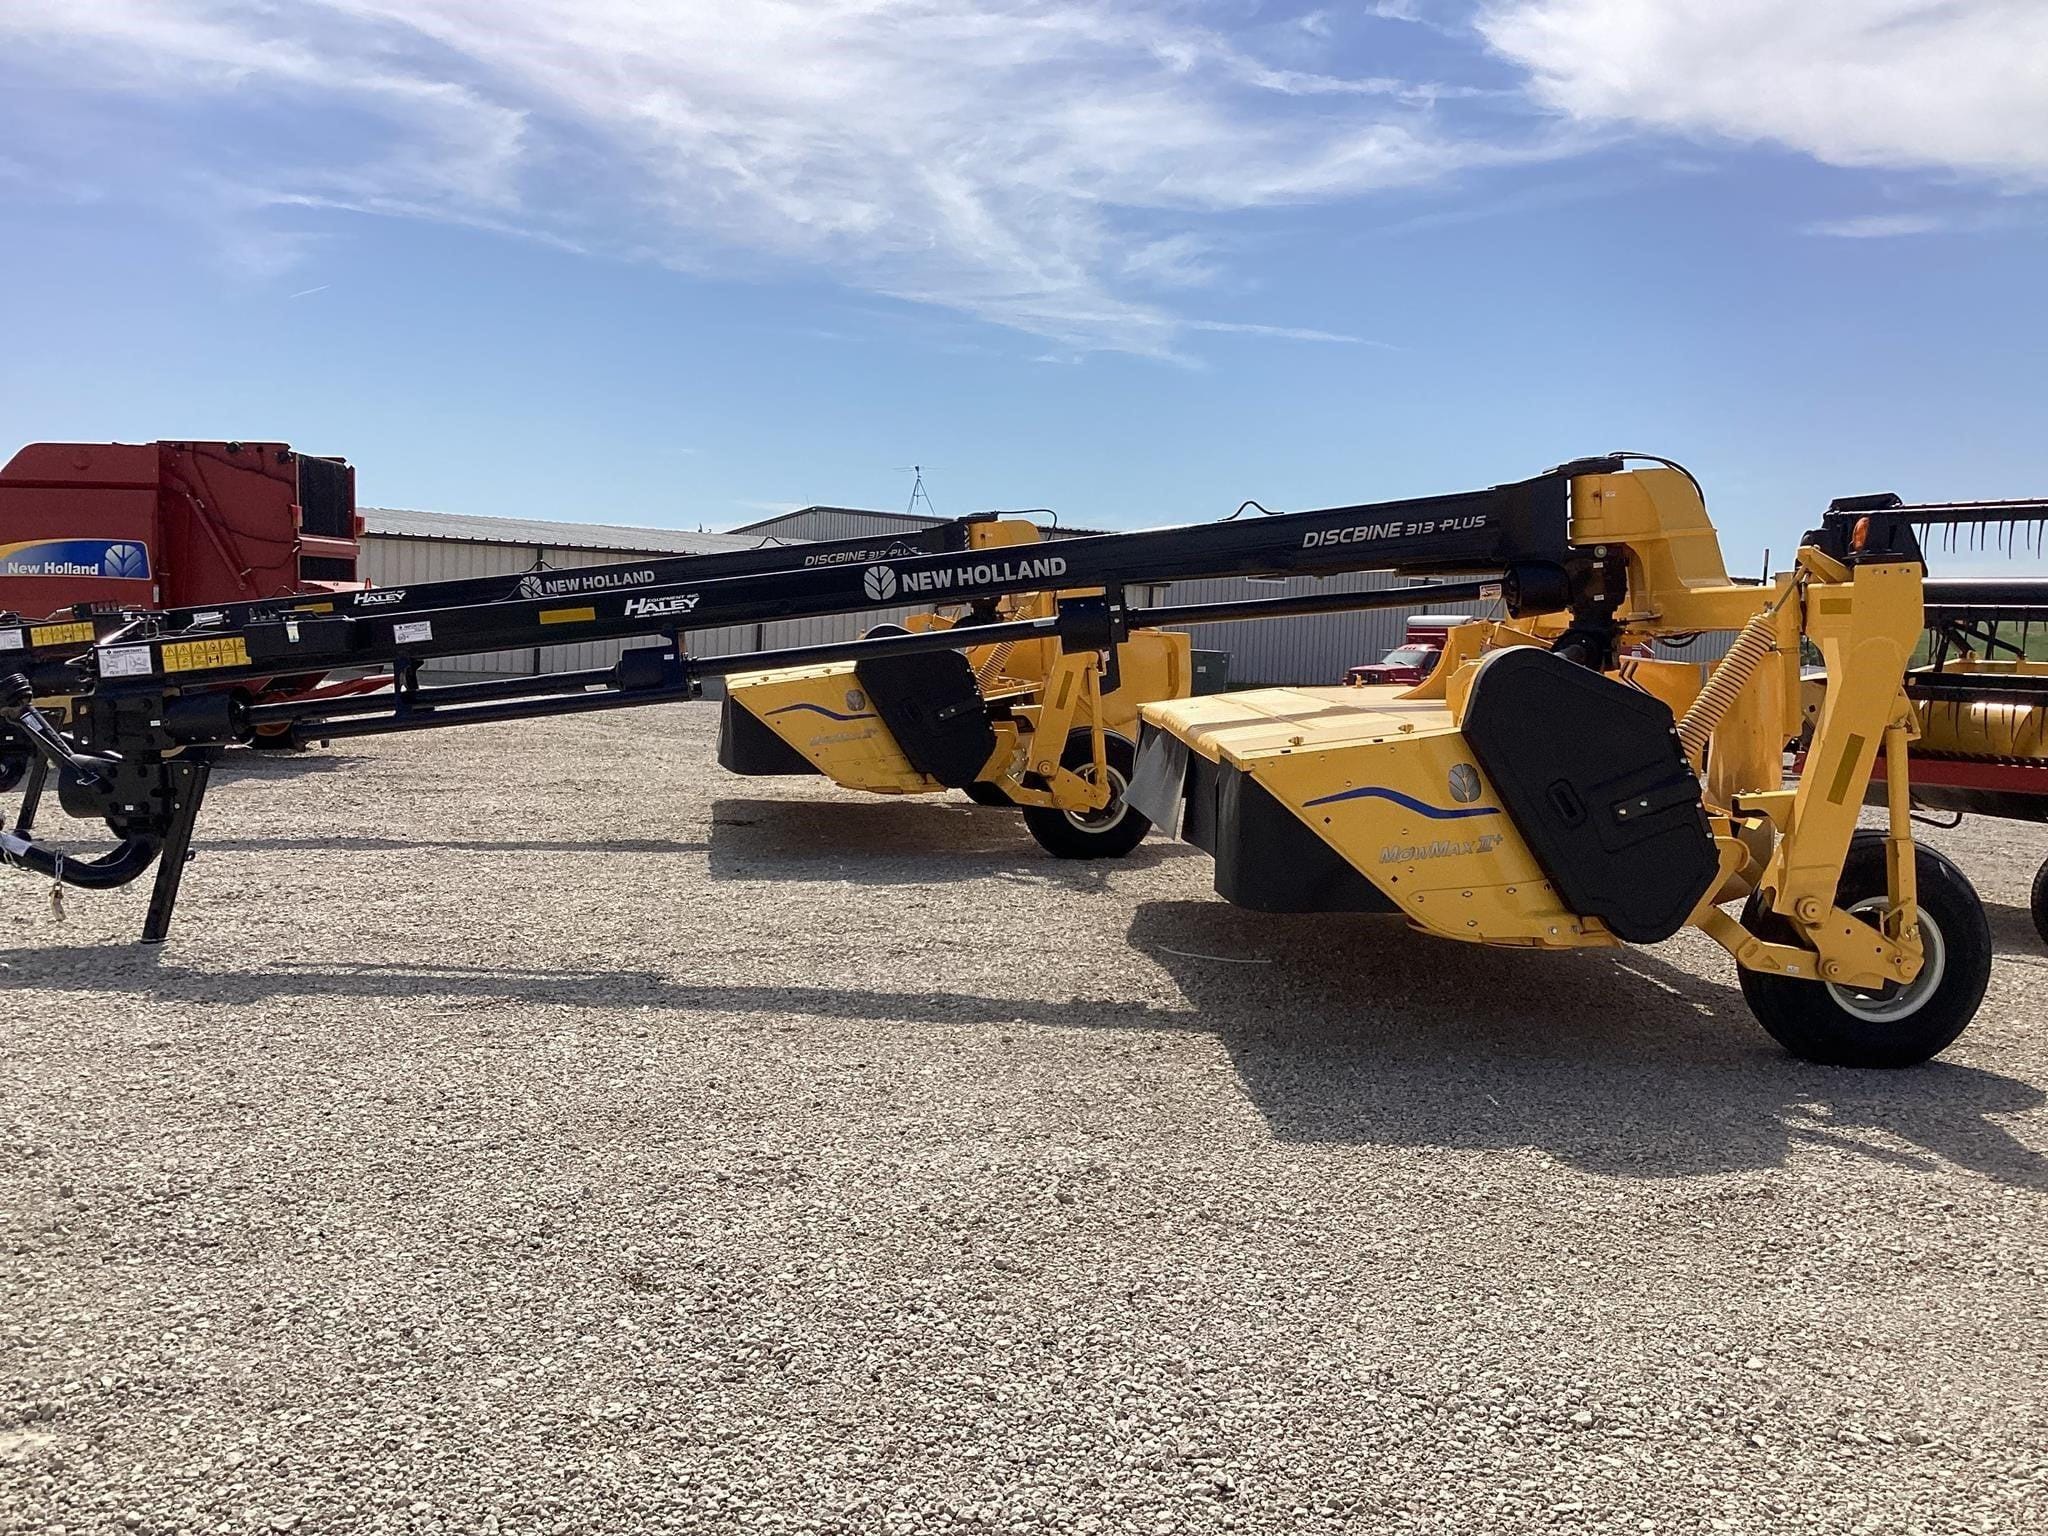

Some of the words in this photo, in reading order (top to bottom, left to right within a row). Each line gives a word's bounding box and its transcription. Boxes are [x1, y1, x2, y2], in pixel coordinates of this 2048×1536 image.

[1302, 522, 1403, 548] DISCBINE
[1405, 522, 1434, 536] 313
[804, 550, 867, 567] DISCBINE
[7, 562, 40, 574] New
[44, 562, 99, 575] Holland
[902, 569, 952, 592] NEW
[957, 557, 1067, 586] HOLLAND
[546, 578, 579, 593] NEW
[583, 571, 655, 590] HOLLAND
[353, 592, 407, 604] HALEY
[624, 598, 700, 616] HALEY
